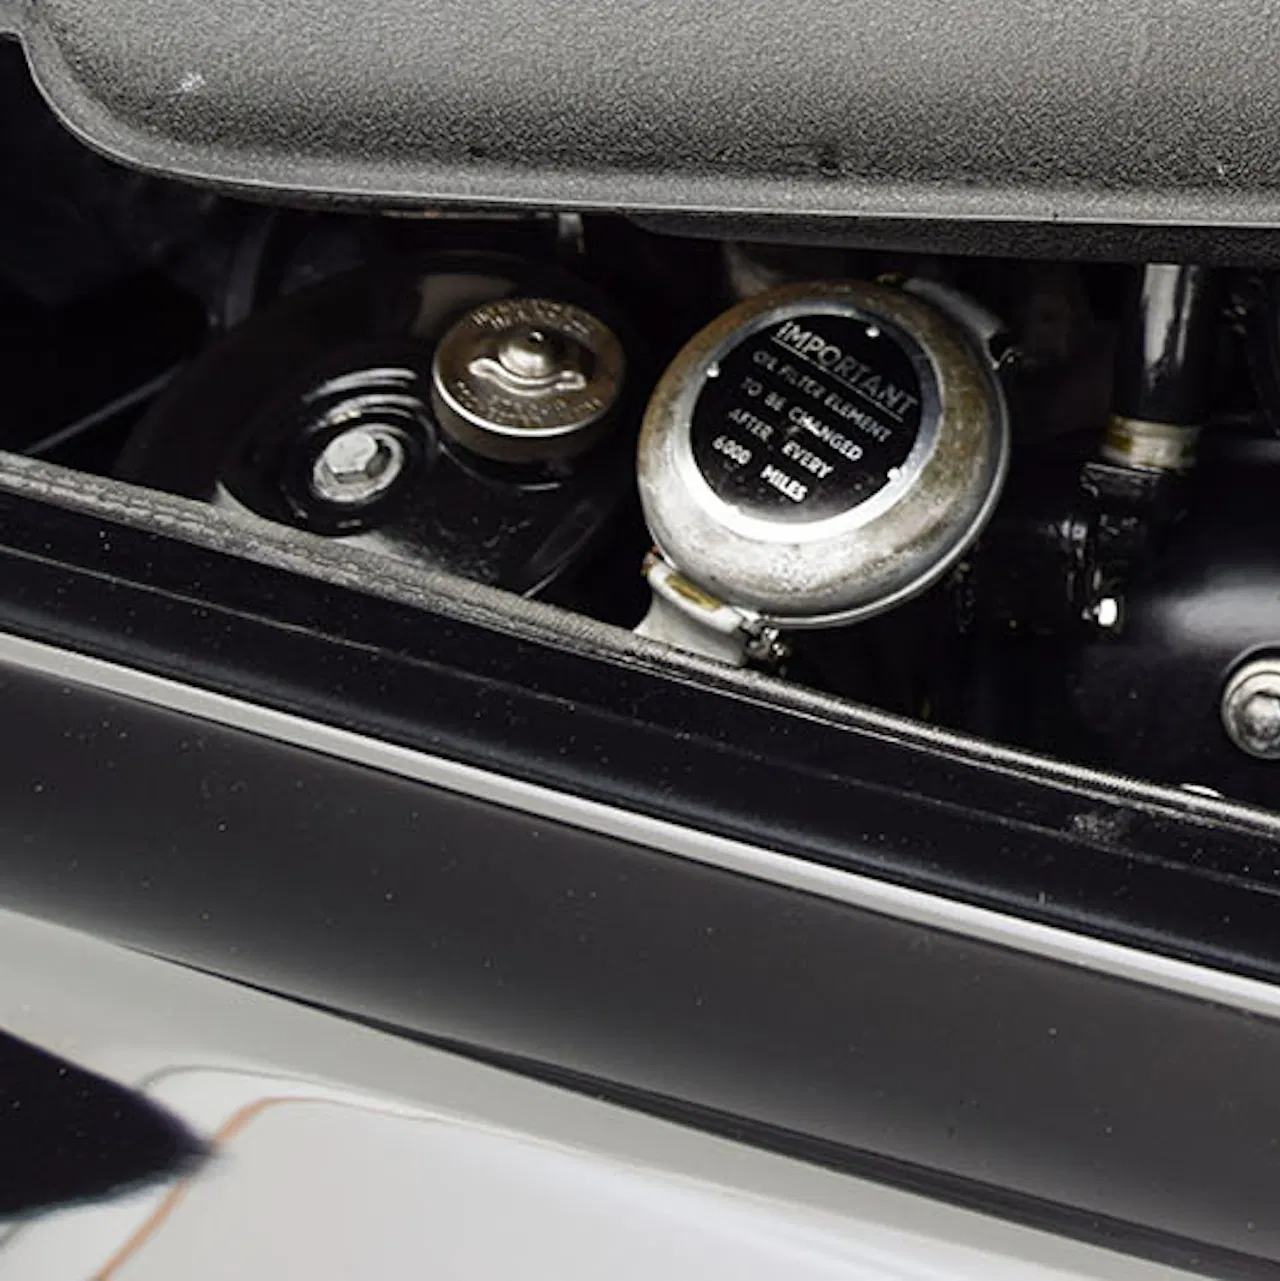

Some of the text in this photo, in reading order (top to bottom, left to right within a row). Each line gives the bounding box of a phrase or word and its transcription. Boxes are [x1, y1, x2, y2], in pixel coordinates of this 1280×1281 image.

[751, 348, 893, 443] OIL FILTER ELEMENT
[776, 319, 918, 416] IMPORTANT
[727, 406, 834, 479] AFTER EVERY
[740, 376, 864, 462] TO BE CHANGED
[711, 433, 809, 502] 6000 MILES
